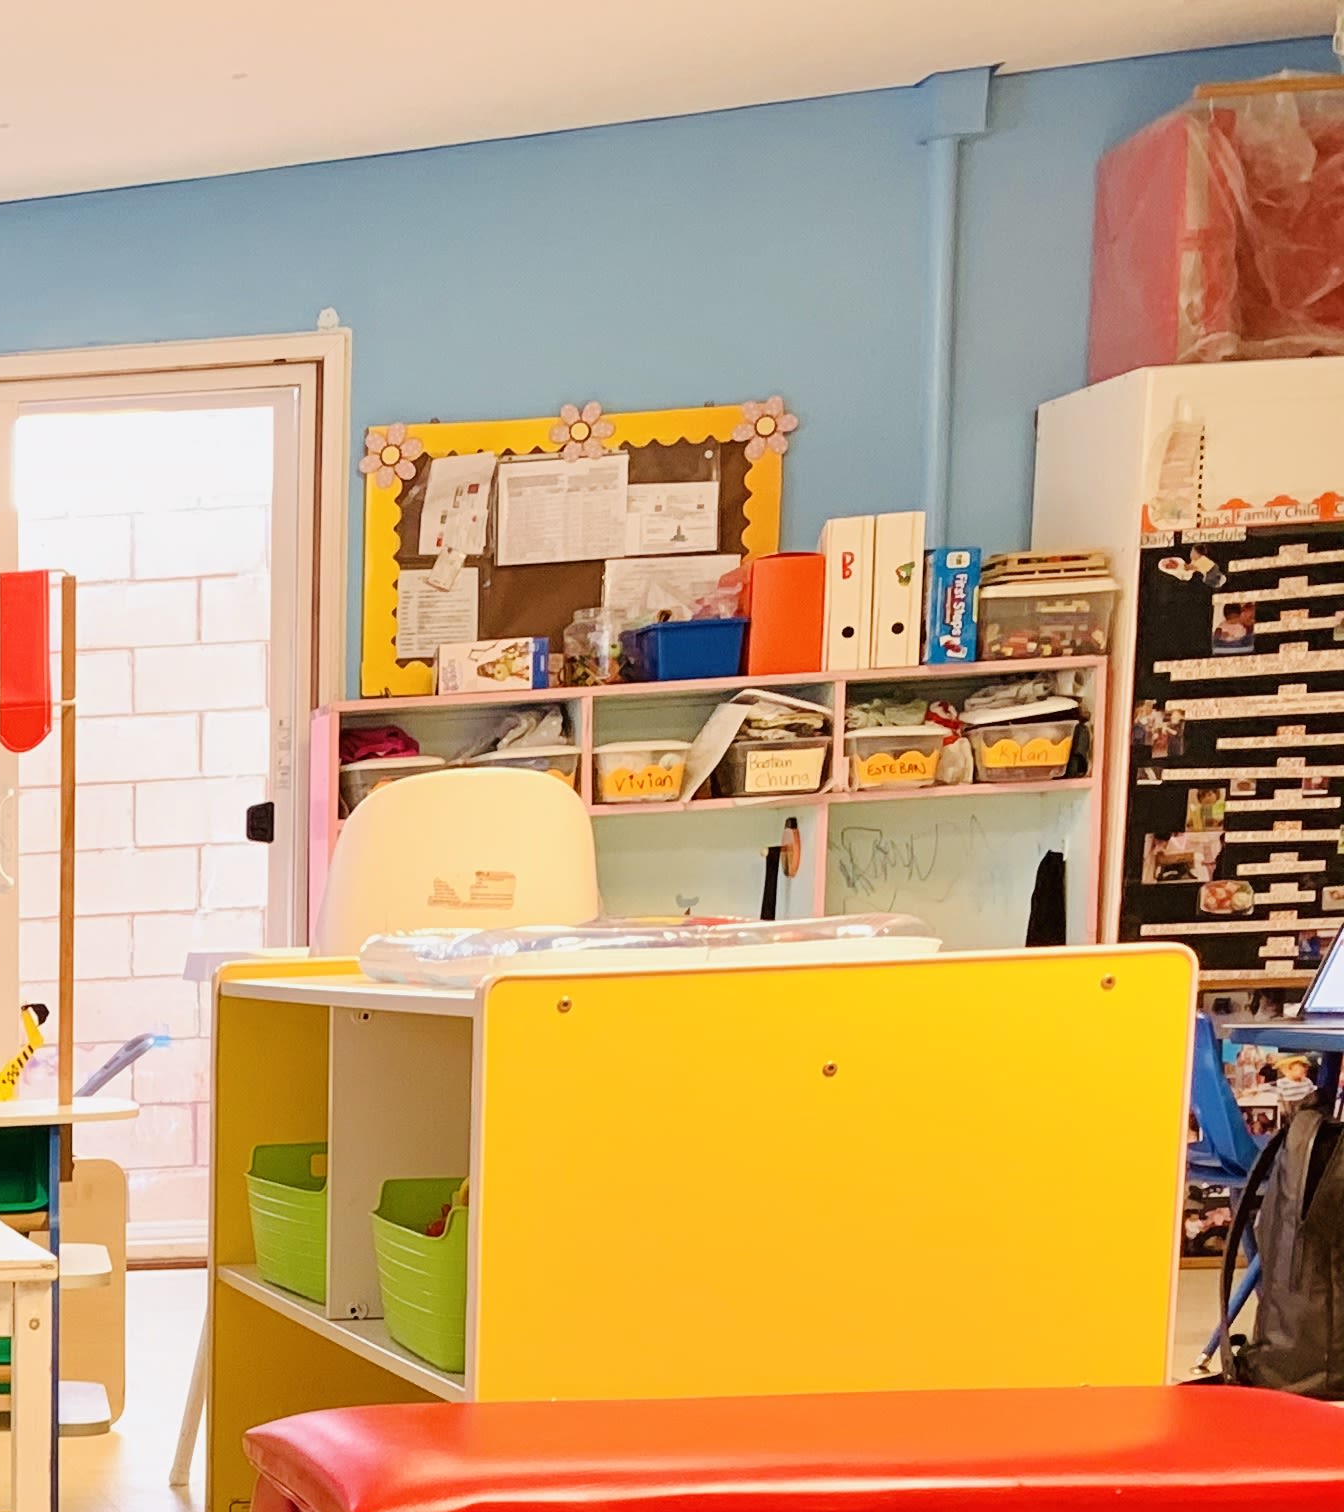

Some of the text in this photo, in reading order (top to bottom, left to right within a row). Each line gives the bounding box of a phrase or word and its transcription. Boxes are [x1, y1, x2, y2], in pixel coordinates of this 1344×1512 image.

[1236, 506, 1281, 522] Family
[1141, 528, 1247, 548] Daily Schedule
[841, 551, 855, 580] B
